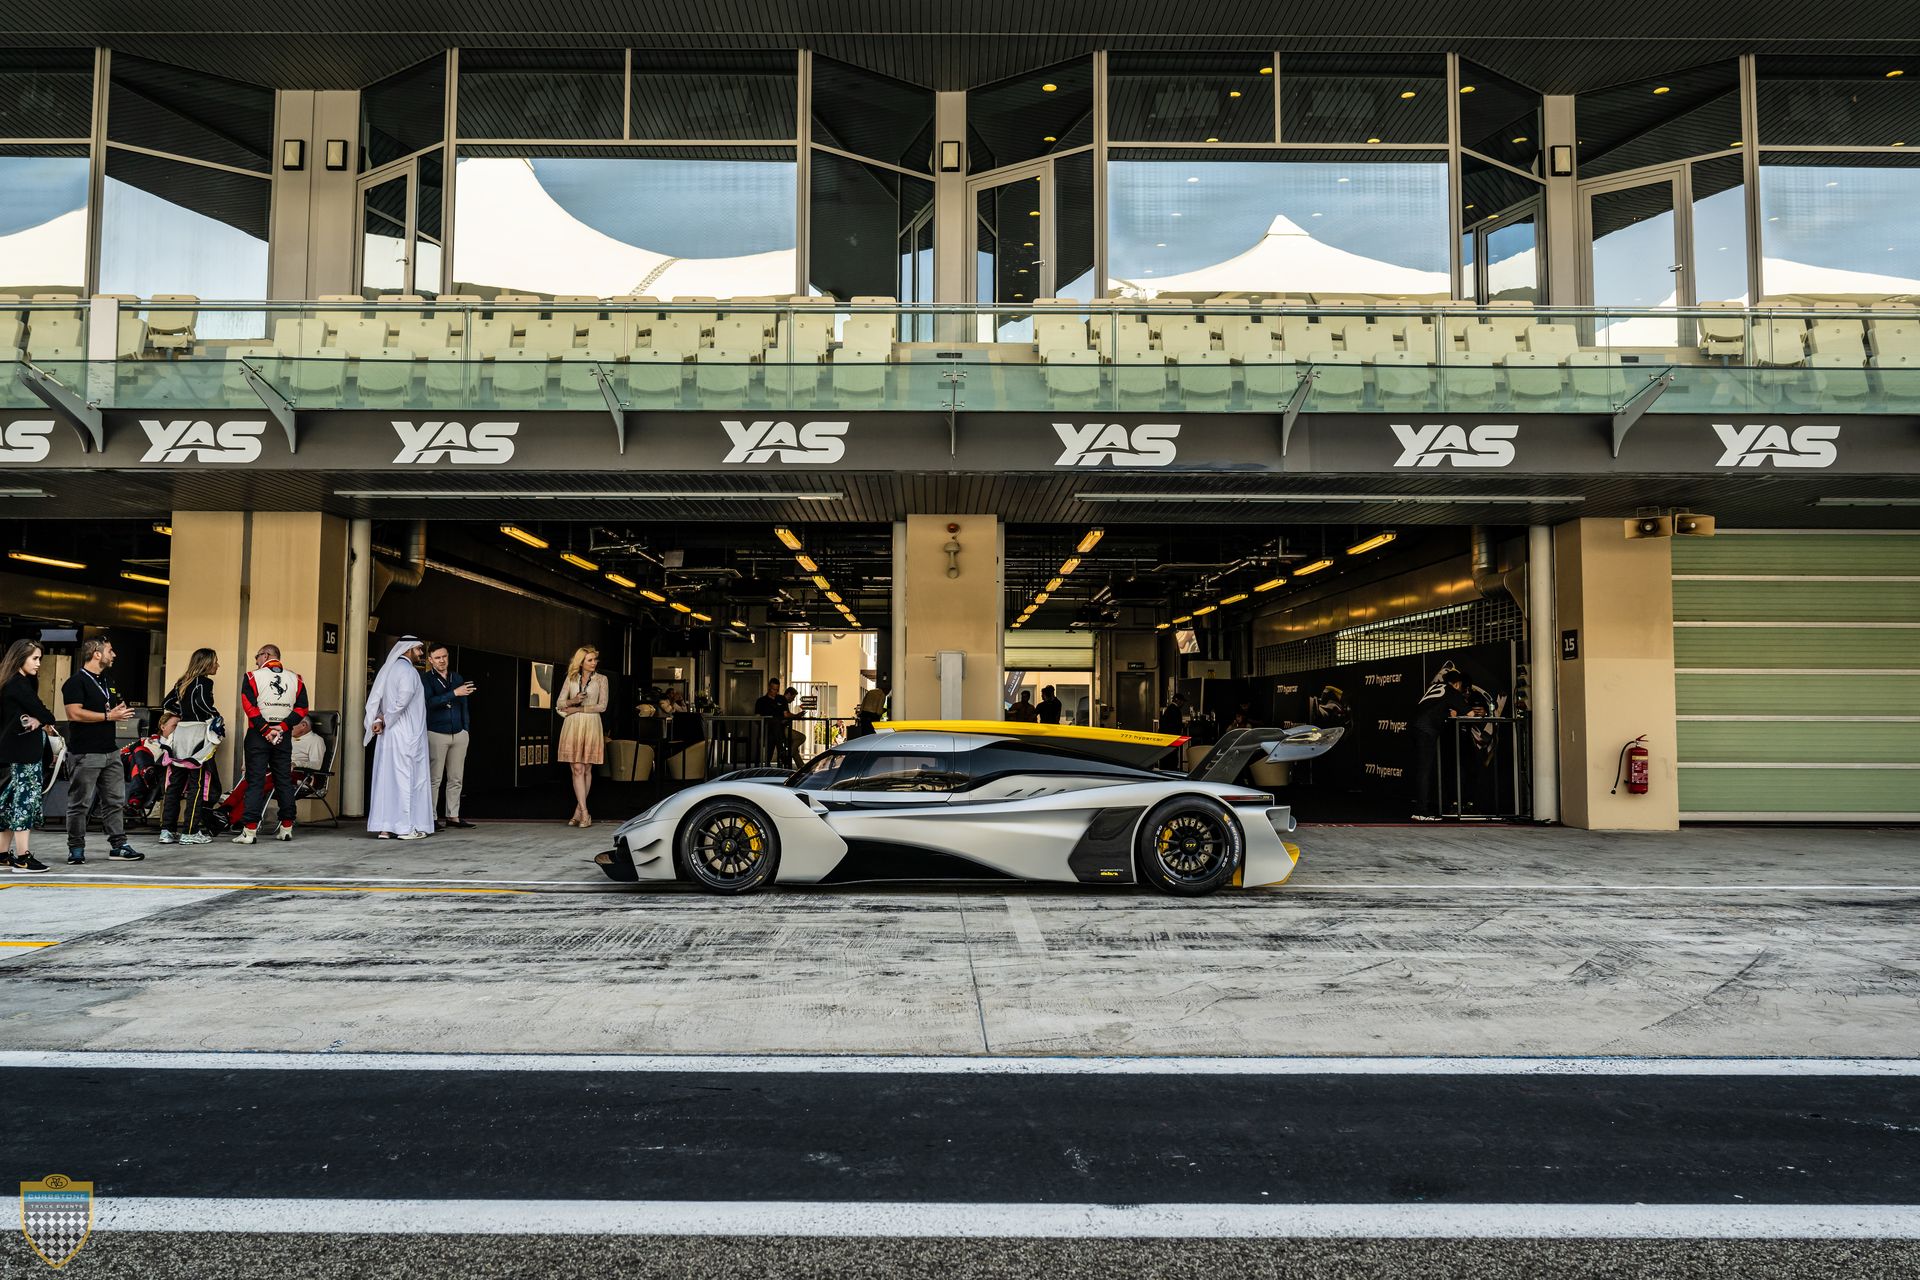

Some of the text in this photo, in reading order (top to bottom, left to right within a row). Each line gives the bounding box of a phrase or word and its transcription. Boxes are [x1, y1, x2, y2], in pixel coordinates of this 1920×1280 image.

[139, 421, 267, 463] YAS
[392, 422, 519, 463] YAS
[721, 421, 849, 463] YAS
[1052, 424, 1181, 466] YAS
[1390, 425, 1519, 467] YAS
[1712, 425, 1840, 467] YAS
[326, 631, 335, 644] 16
[1565, 638, 1575, 651] 15
[1365, 673, 1402, 686] 777 hypercar
[1378, 720, 1389, 731] 777
[1365, 763, 1403, 777] 777 hypercar
